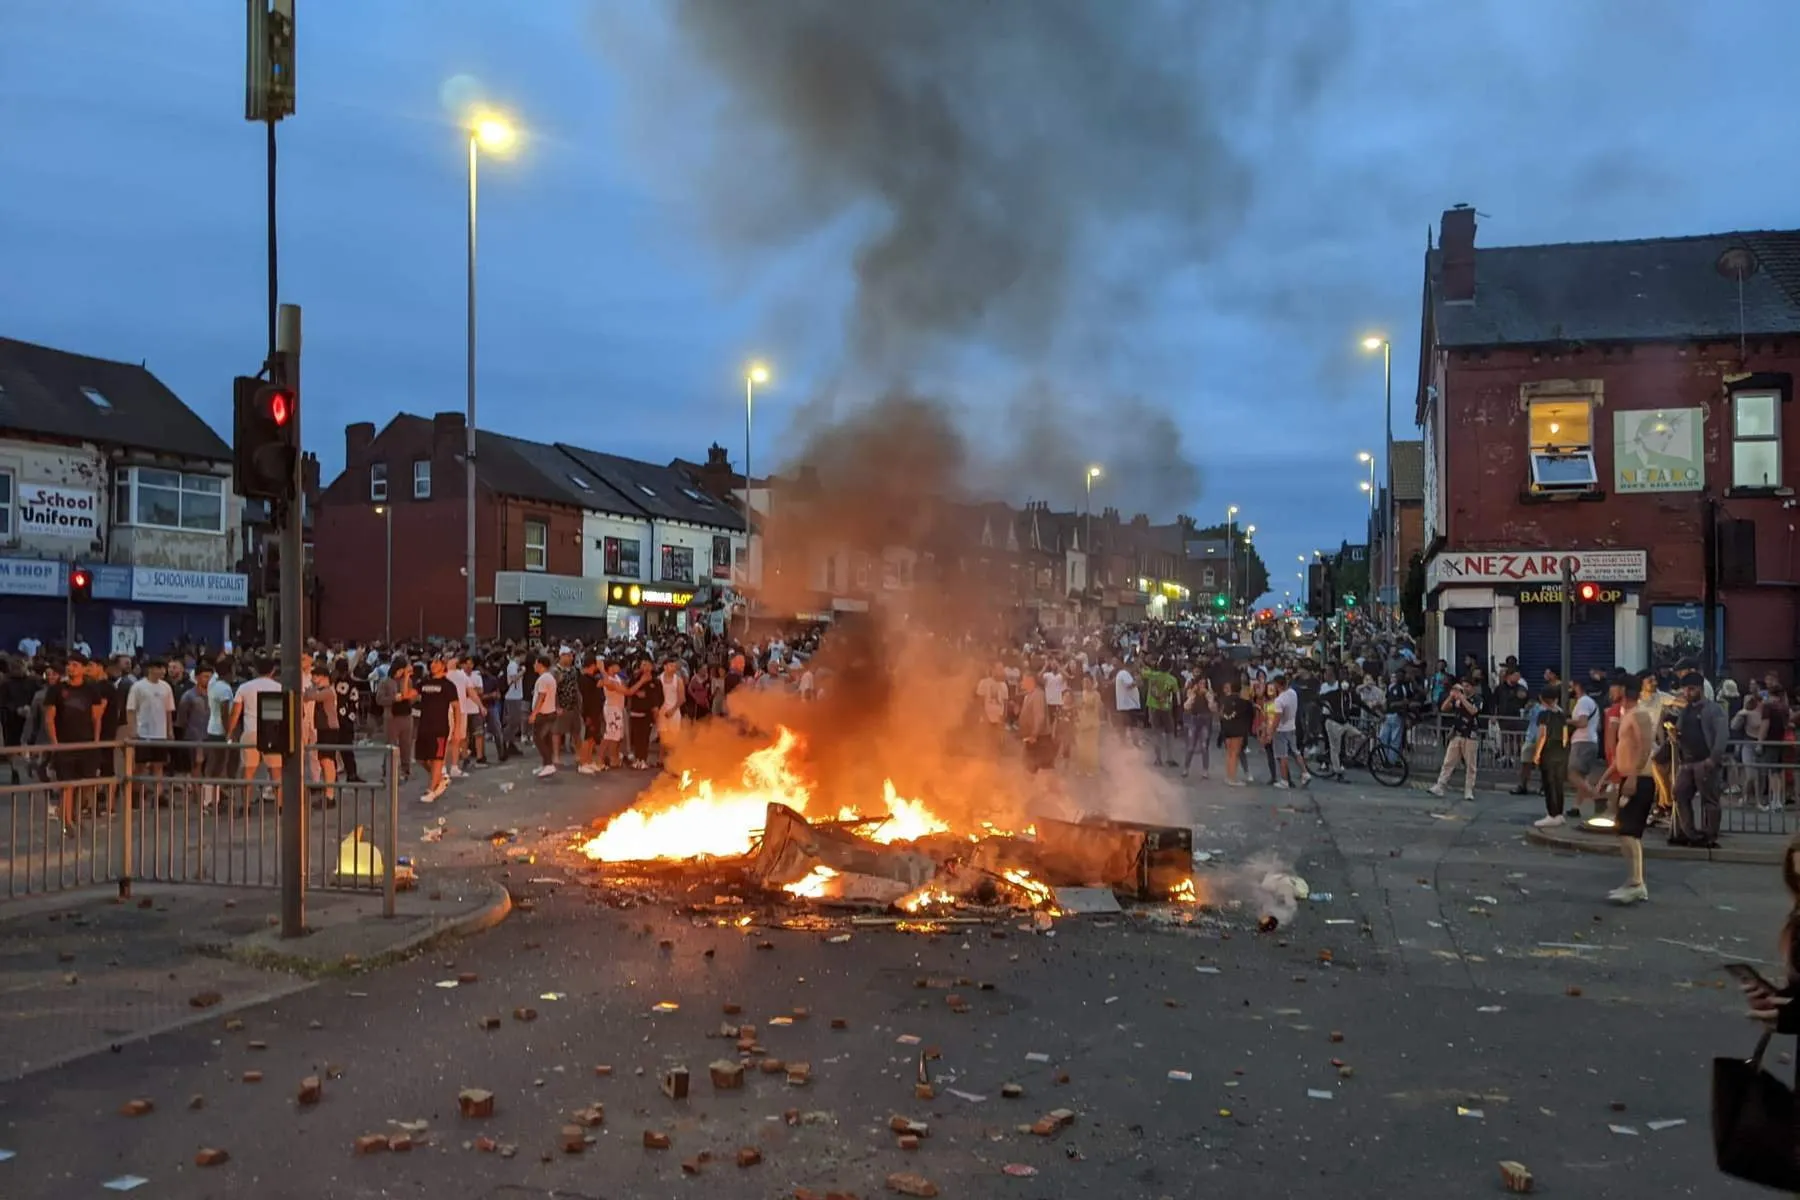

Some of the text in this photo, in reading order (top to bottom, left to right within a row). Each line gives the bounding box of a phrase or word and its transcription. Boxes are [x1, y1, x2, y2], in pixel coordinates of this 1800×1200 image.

[28, 489, 93, 511] School
[19, 504, 93, 528] Uniform
[1464, 555, 1581, 580] NEZARO
[154, 571, 245, 592] SCHOOLWEAR SPECIALIST
